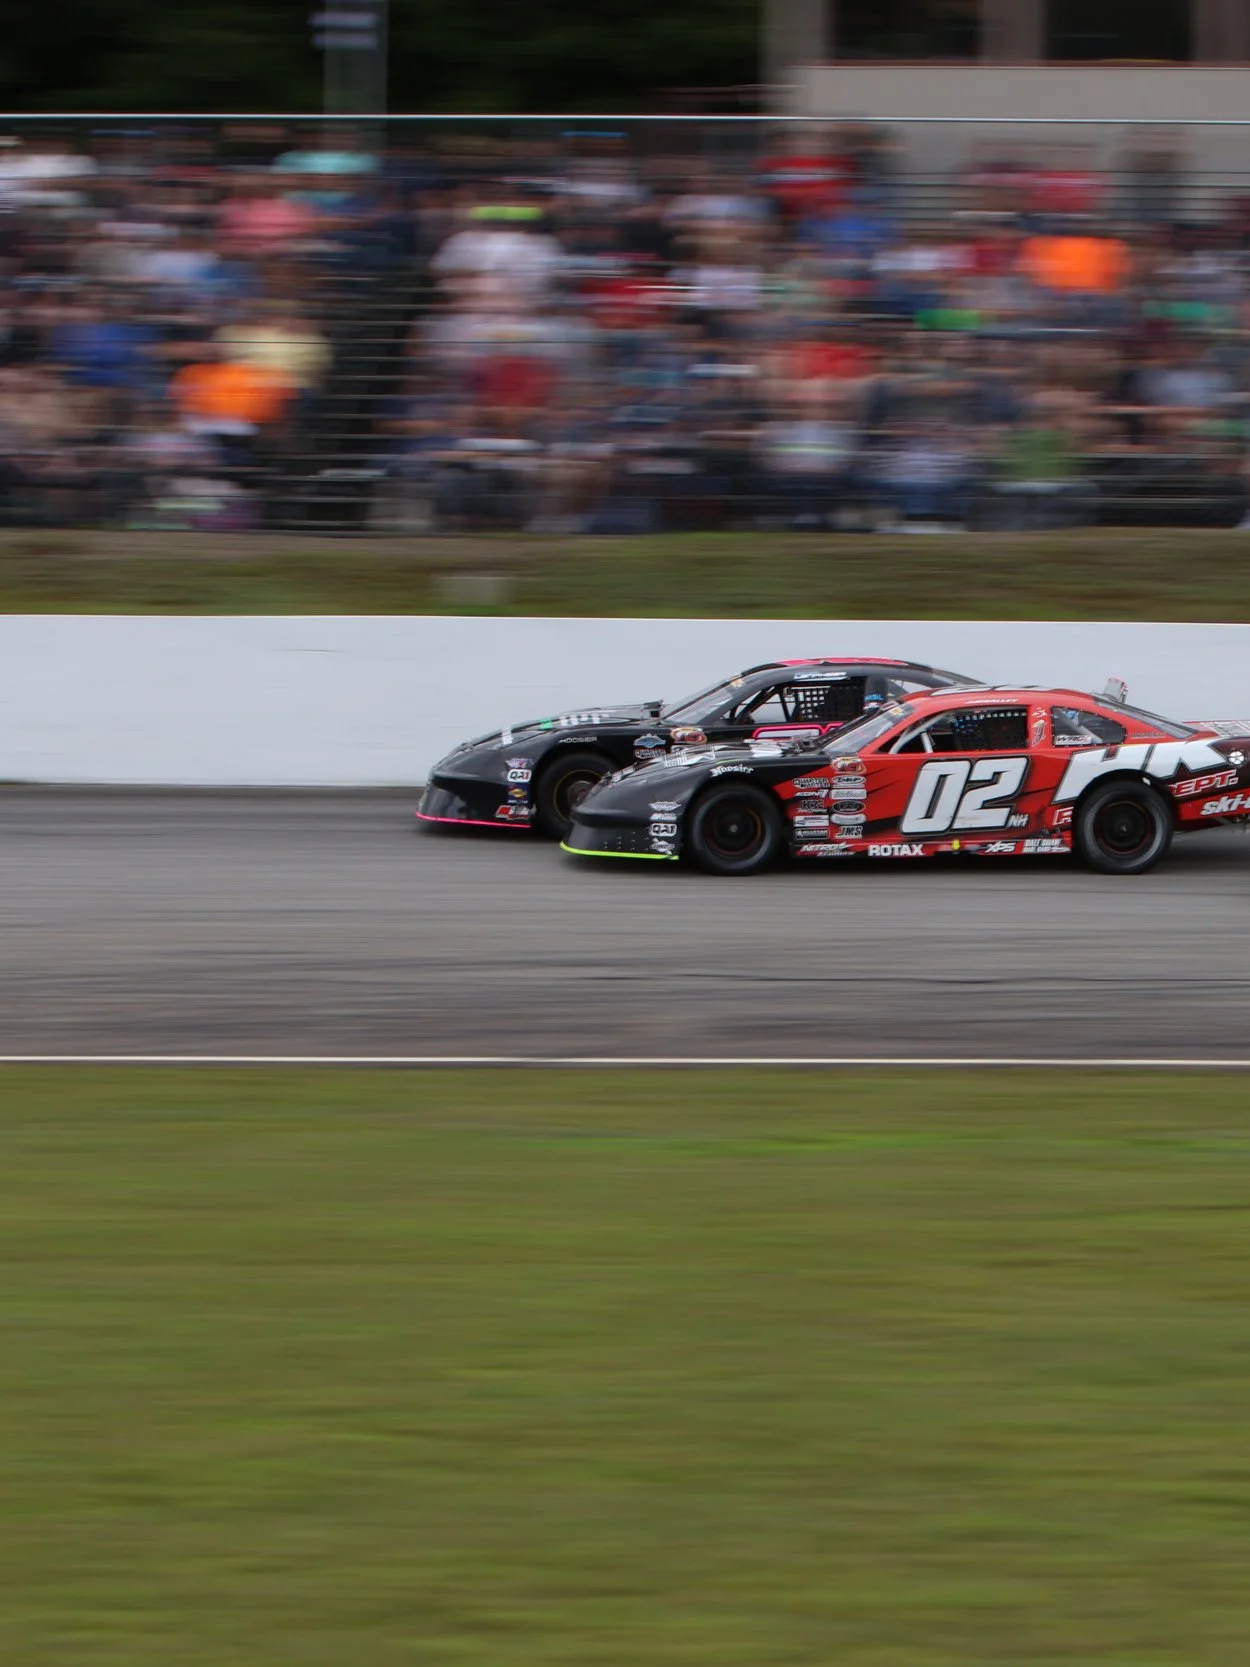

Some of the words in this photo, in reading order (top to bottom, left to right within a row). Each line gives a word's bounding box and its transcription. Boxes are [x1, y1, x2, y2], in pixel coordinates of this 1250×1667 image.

[509, 771, 530, 780] QA1
[710, 764, 754, 777] Hoosier
[1168, 770, 1239, 797] EPT.
[901, 757, 1028, 834] 02
[1009, 814, 1029, 827] NH
[652, 824, 675, 834] QA1
[868, 845, 924, 856] ROTAX
